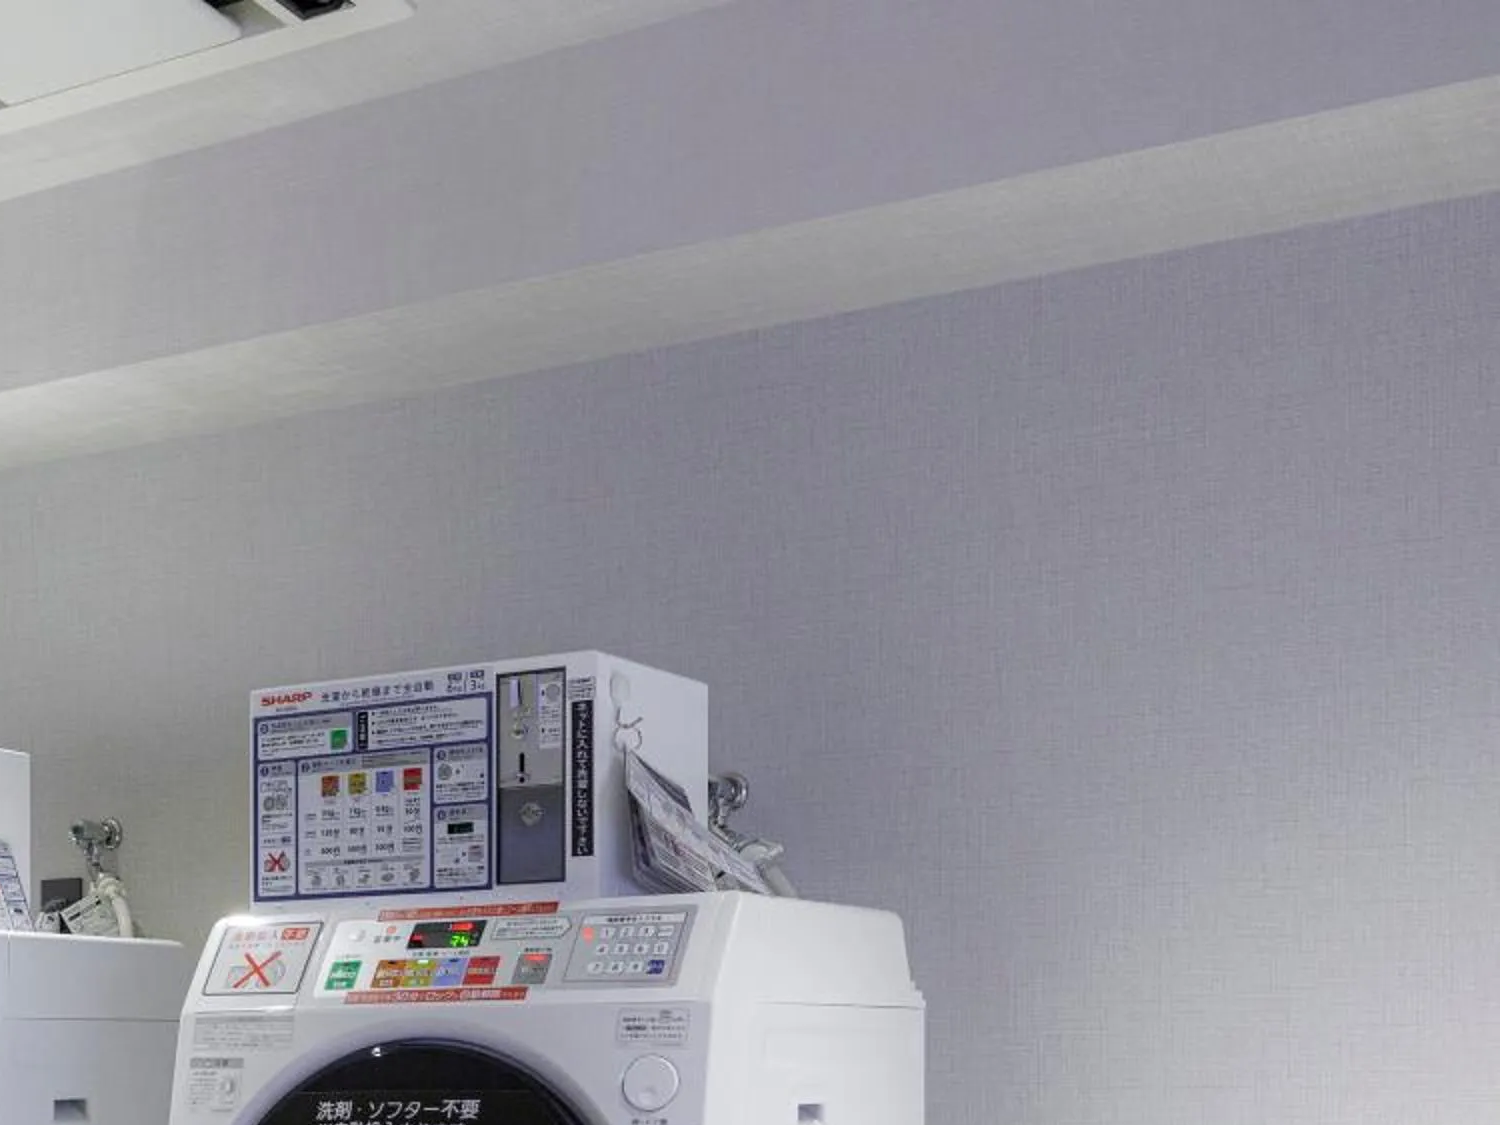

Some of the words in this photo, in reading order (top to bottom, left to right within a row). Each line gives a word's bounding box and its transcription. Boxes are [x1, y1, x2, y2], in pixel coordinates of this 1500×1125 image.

[260, 691, 312, 706] SHARP
[316, 1099, 480, 1120] 洗剤・ソフター不要
